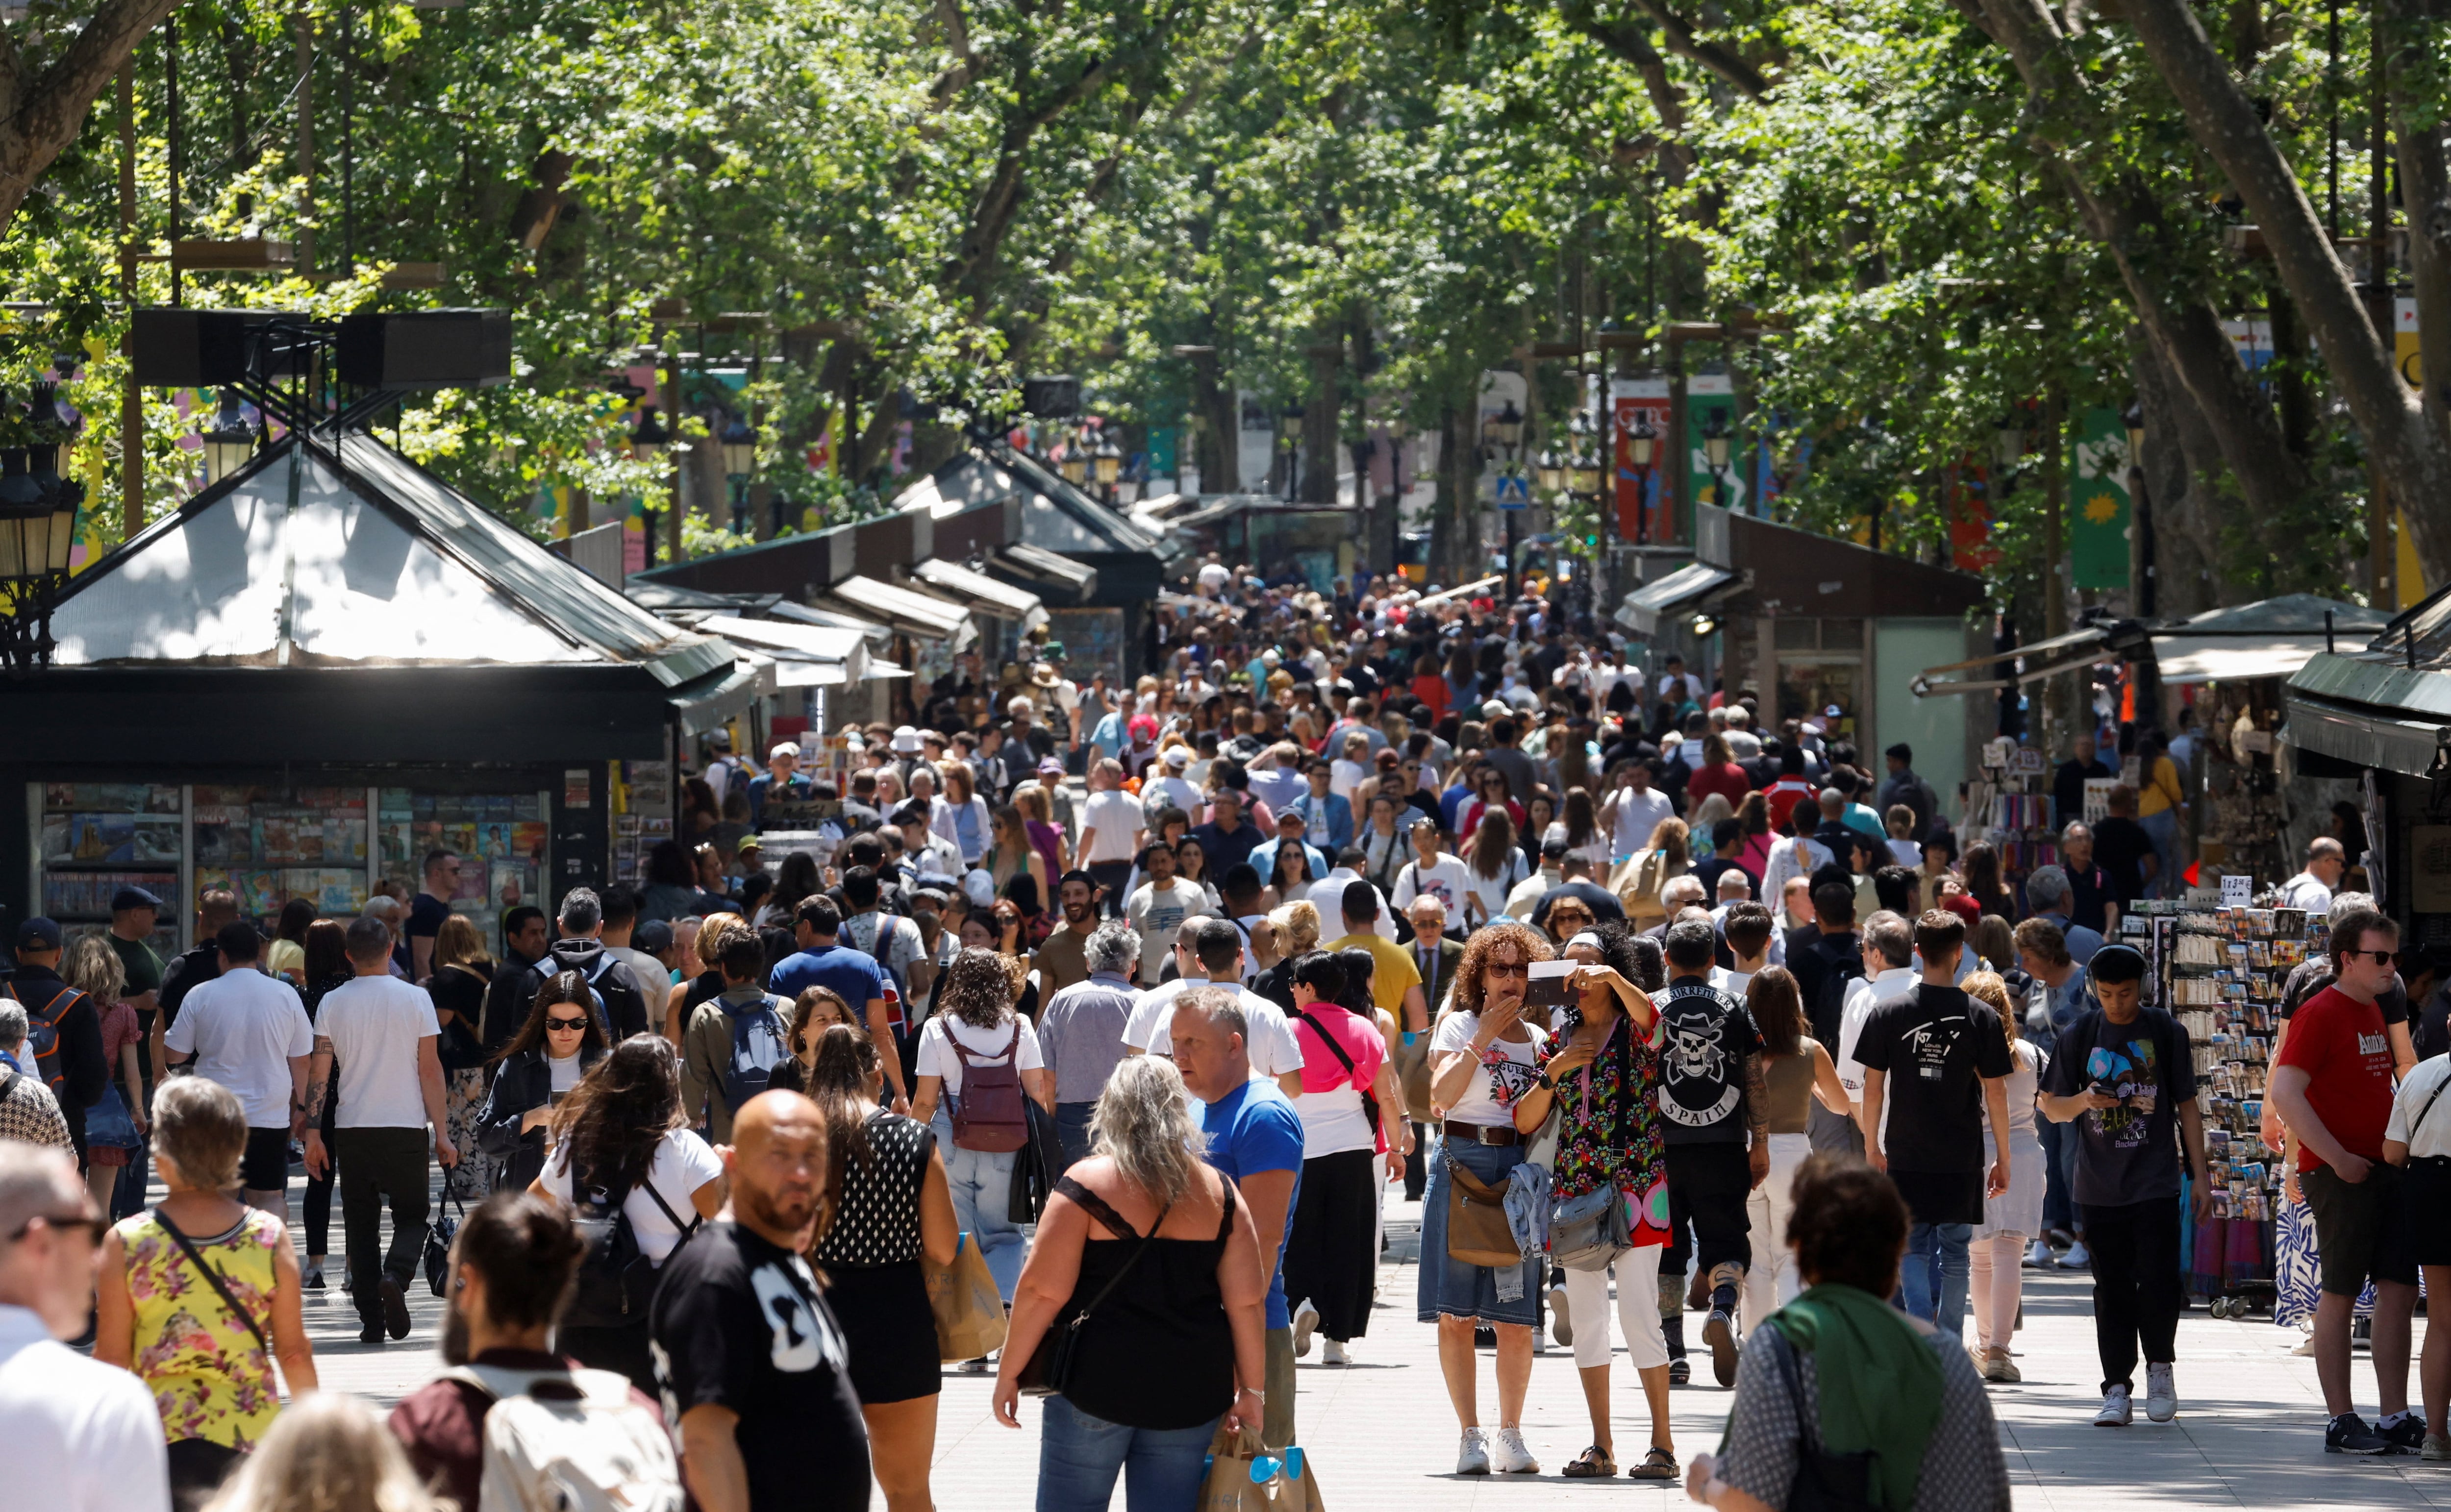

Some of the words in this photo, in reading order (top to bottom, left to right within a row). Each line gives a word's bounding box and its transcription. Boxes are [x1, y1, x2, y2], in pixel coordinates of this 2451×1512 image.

[1668, 986, 1731, 1010] SURRENDER
[2357, 1029, 2388, 1055] Annie
[1665, 1102, 1728, 1125] SPAIN
